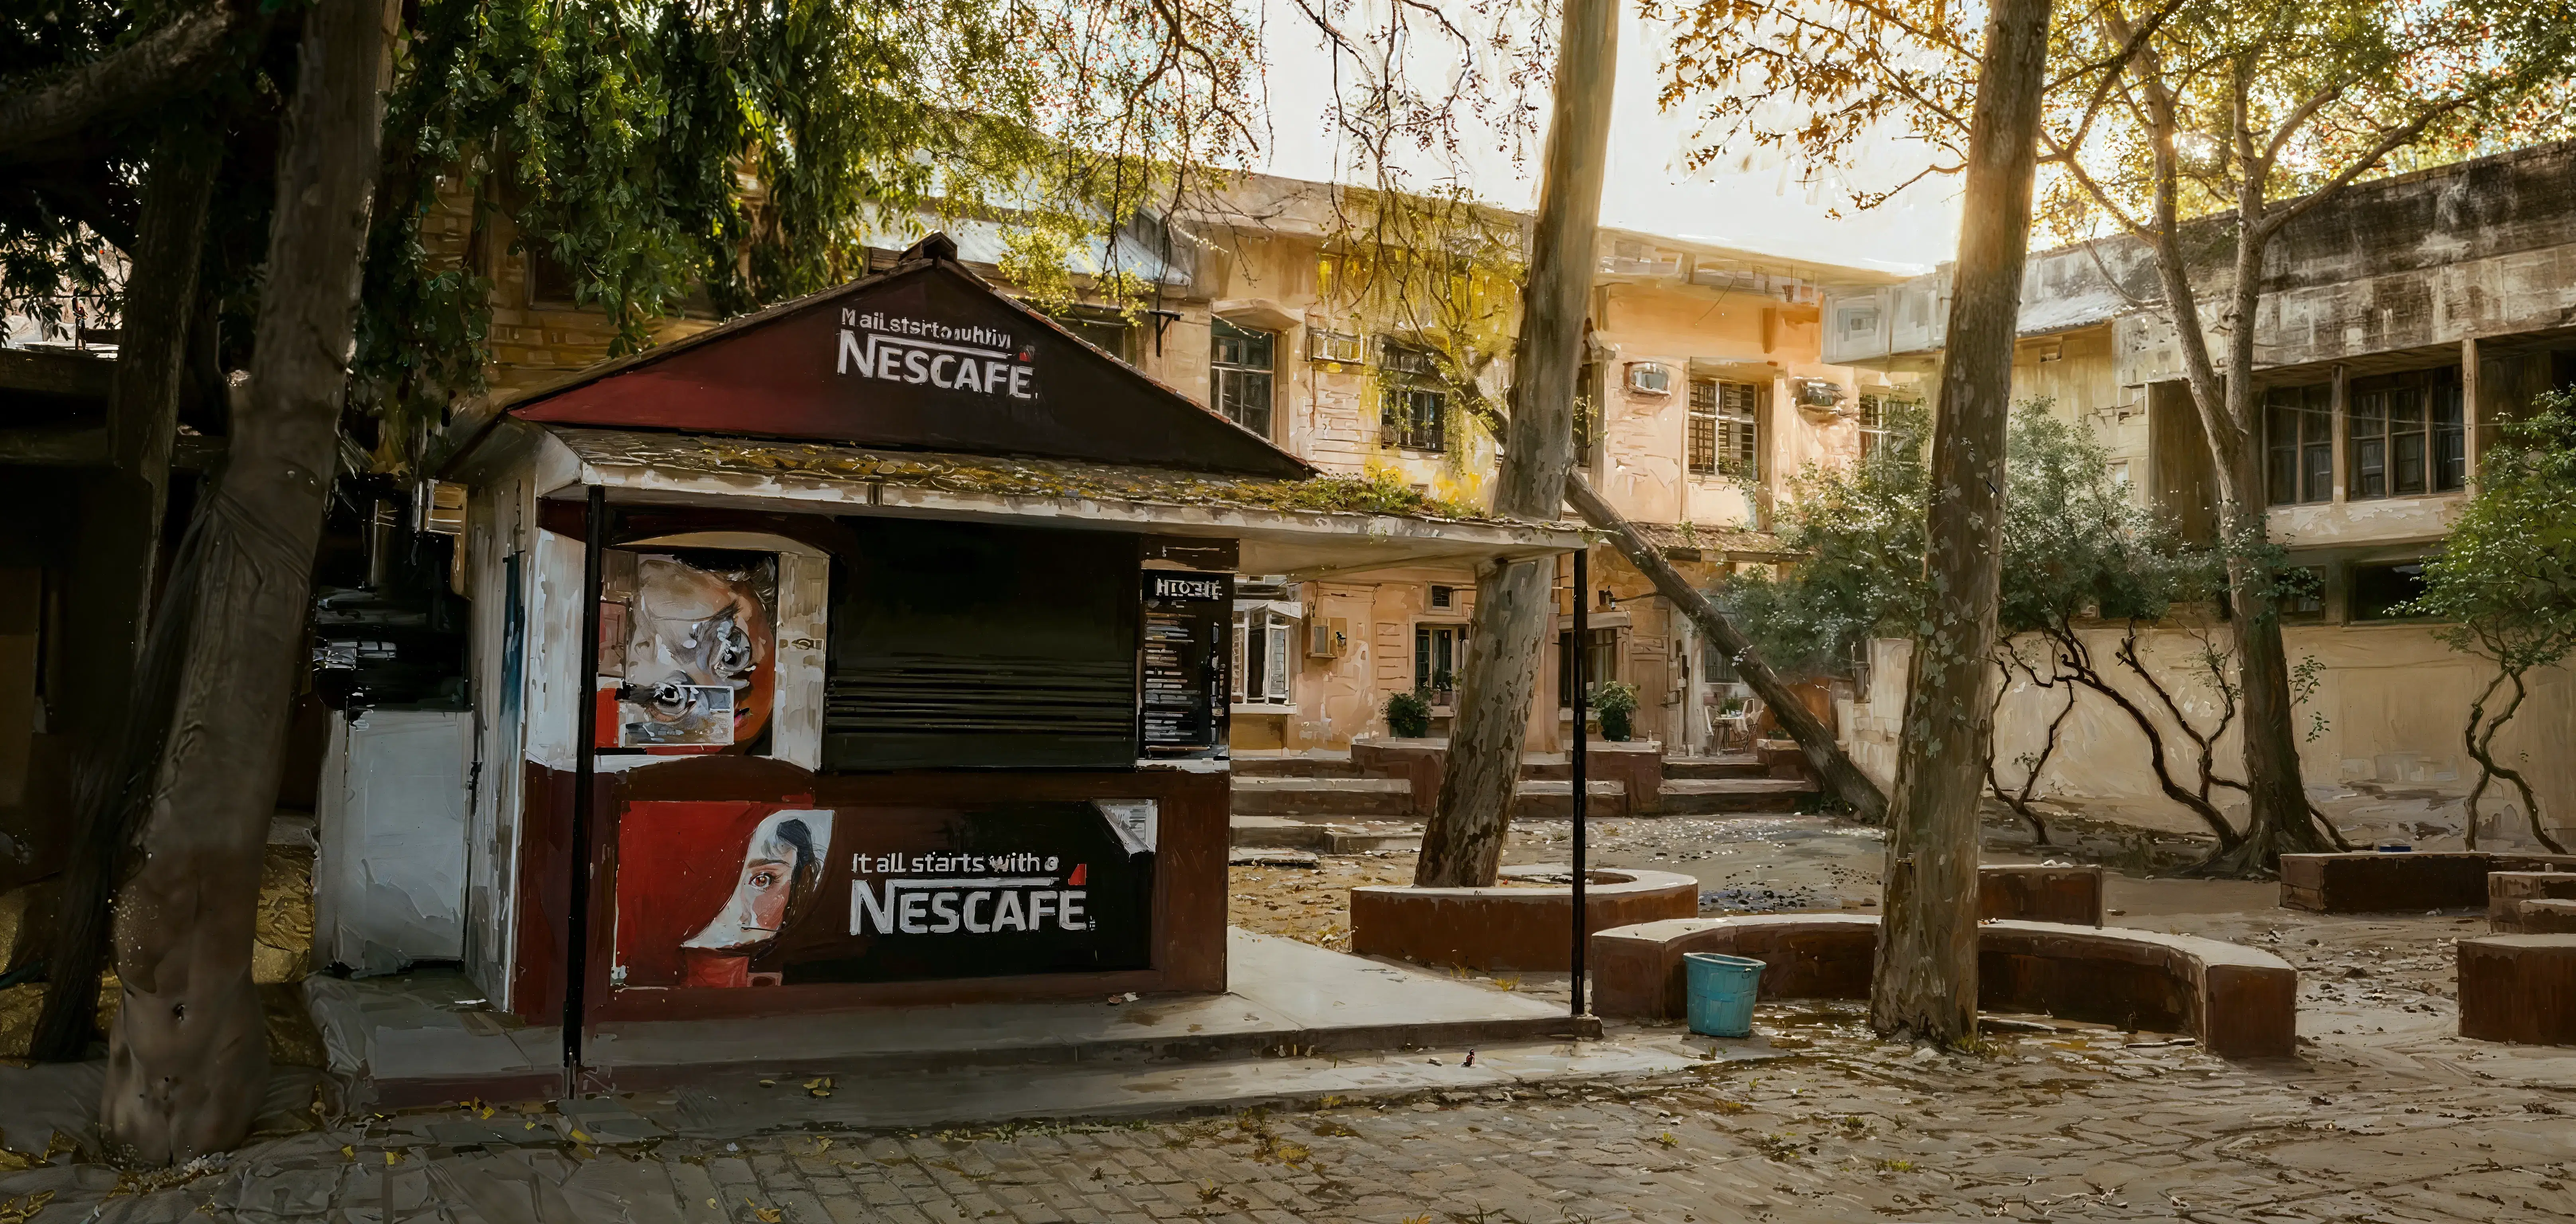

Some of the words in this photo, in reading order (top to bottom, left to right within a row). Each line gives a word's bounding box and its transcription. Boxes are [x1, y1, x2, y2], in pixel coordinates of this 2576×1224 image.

[851, 853, 872, 873] It
[877, 852, 906, 873] all
[911, 851, 986, 873] starts
[988, 852, 1040, 872] with
